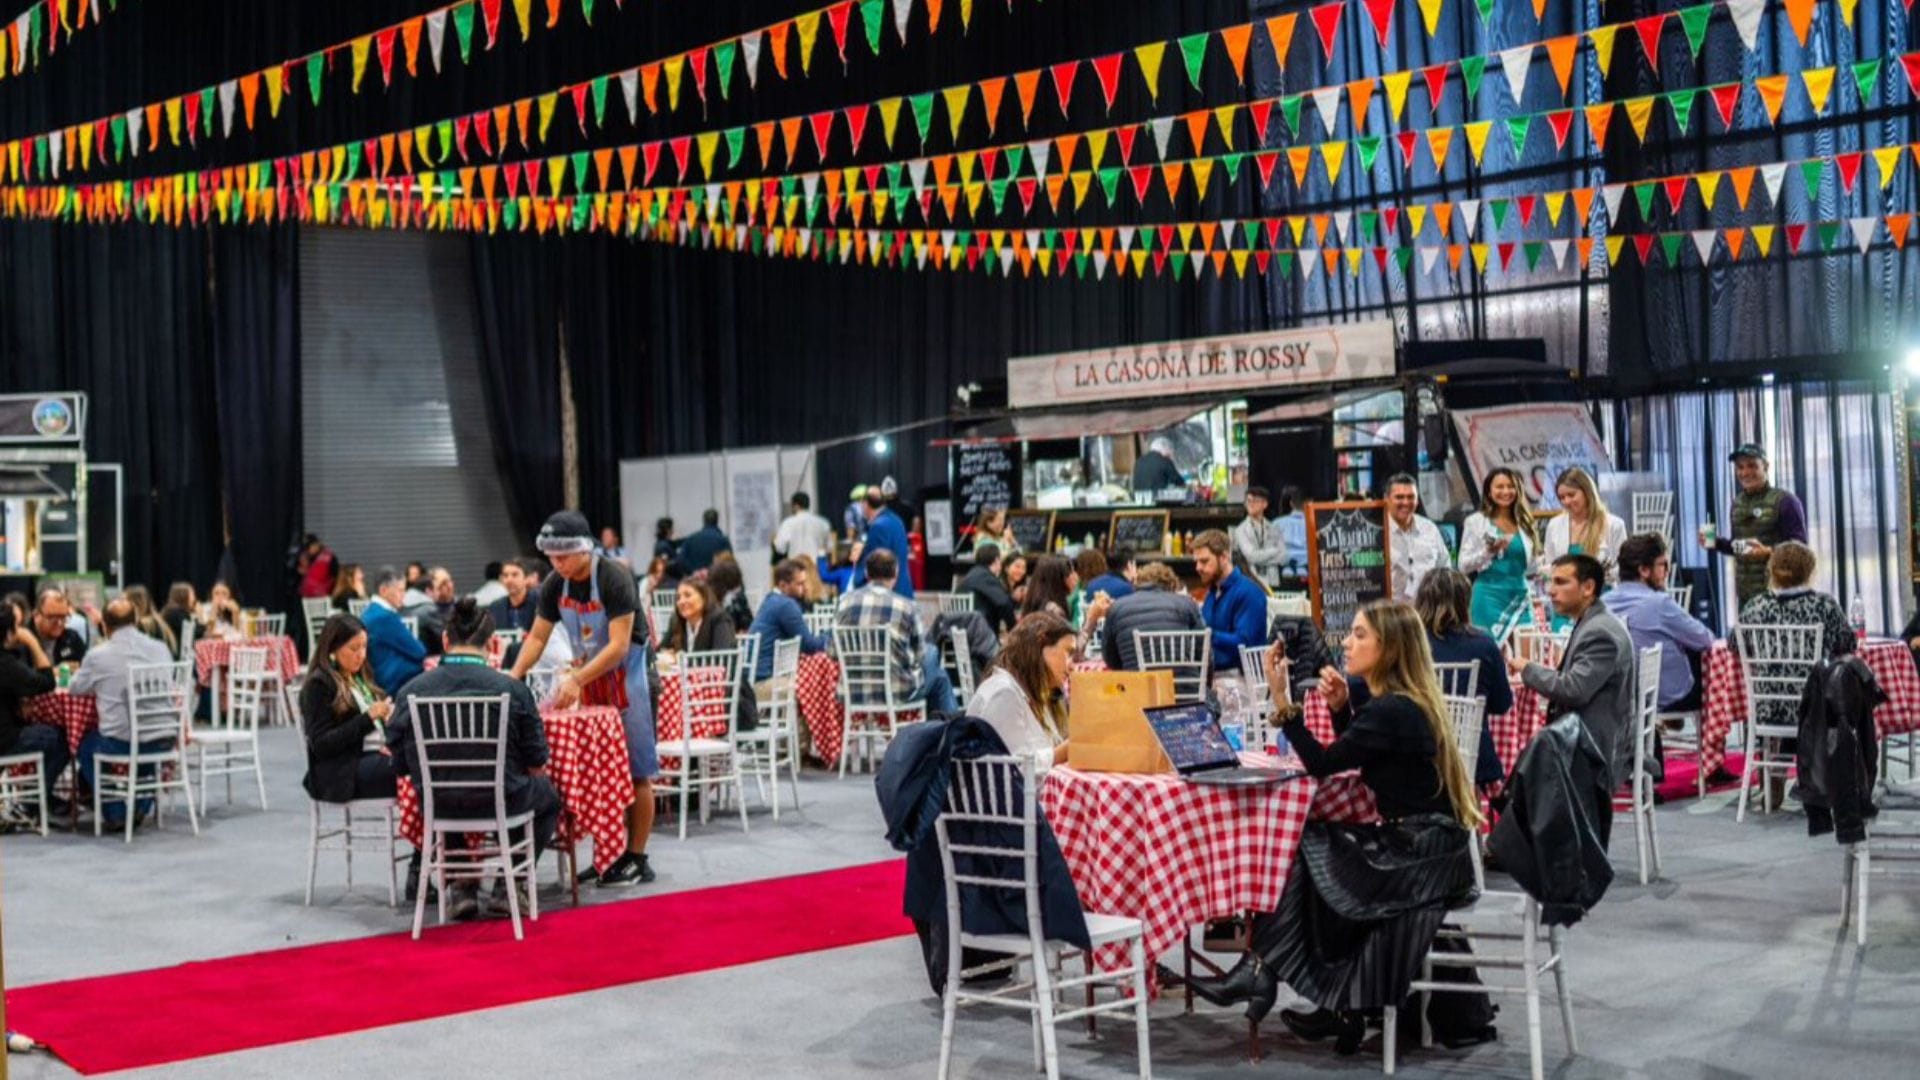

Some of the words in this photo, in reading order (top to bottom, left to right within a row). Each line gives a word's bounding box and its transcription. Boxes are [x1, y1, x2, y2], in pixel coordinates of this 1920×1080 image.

[1075, 364, 1099, 387] LA
[1105, 354, 1191, 385] CASONA
[1200, 351, 1228, 377] DE
[1235, 341, 1312, 374] ROSSY
[1499, 447, 1518, 464] LA
